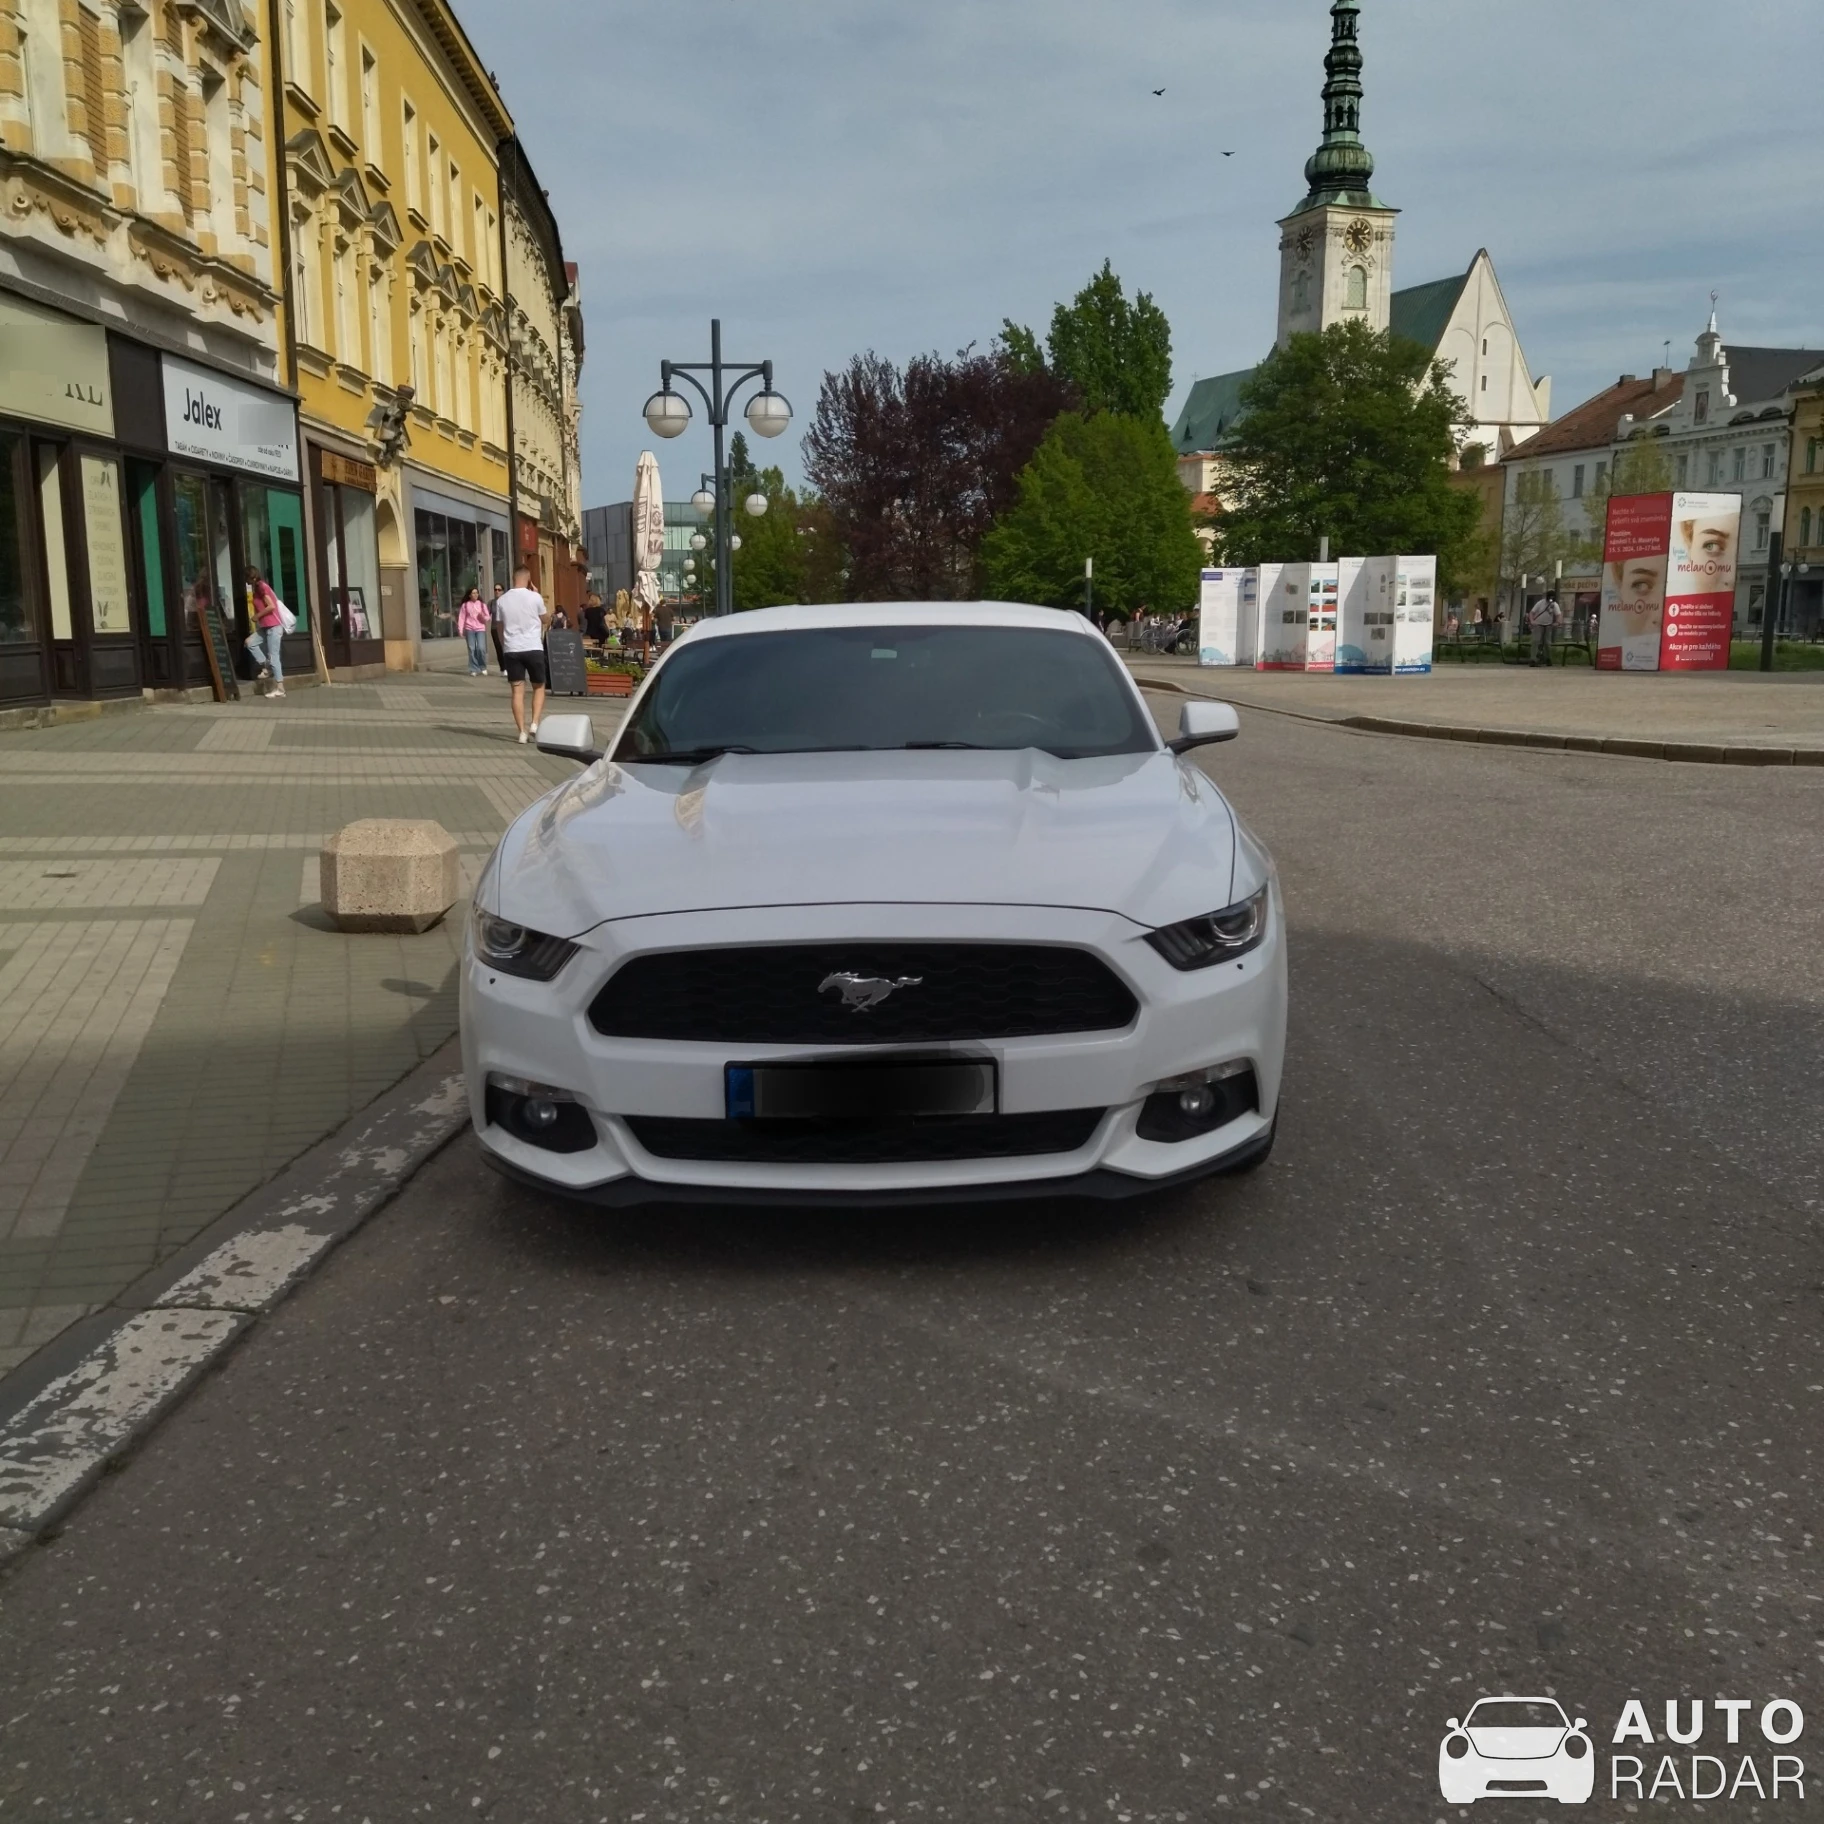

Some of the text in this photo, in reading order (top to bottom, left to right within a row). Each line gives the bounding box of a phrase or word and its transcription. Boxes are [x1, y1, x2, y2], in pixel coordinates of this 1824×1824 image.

[184, 388, 222, 431] Jalex
[1682, 643, 1689, 652] je
[1688, 644, 1699, 652] pro
[1698, 642, 1721, 650] každého
